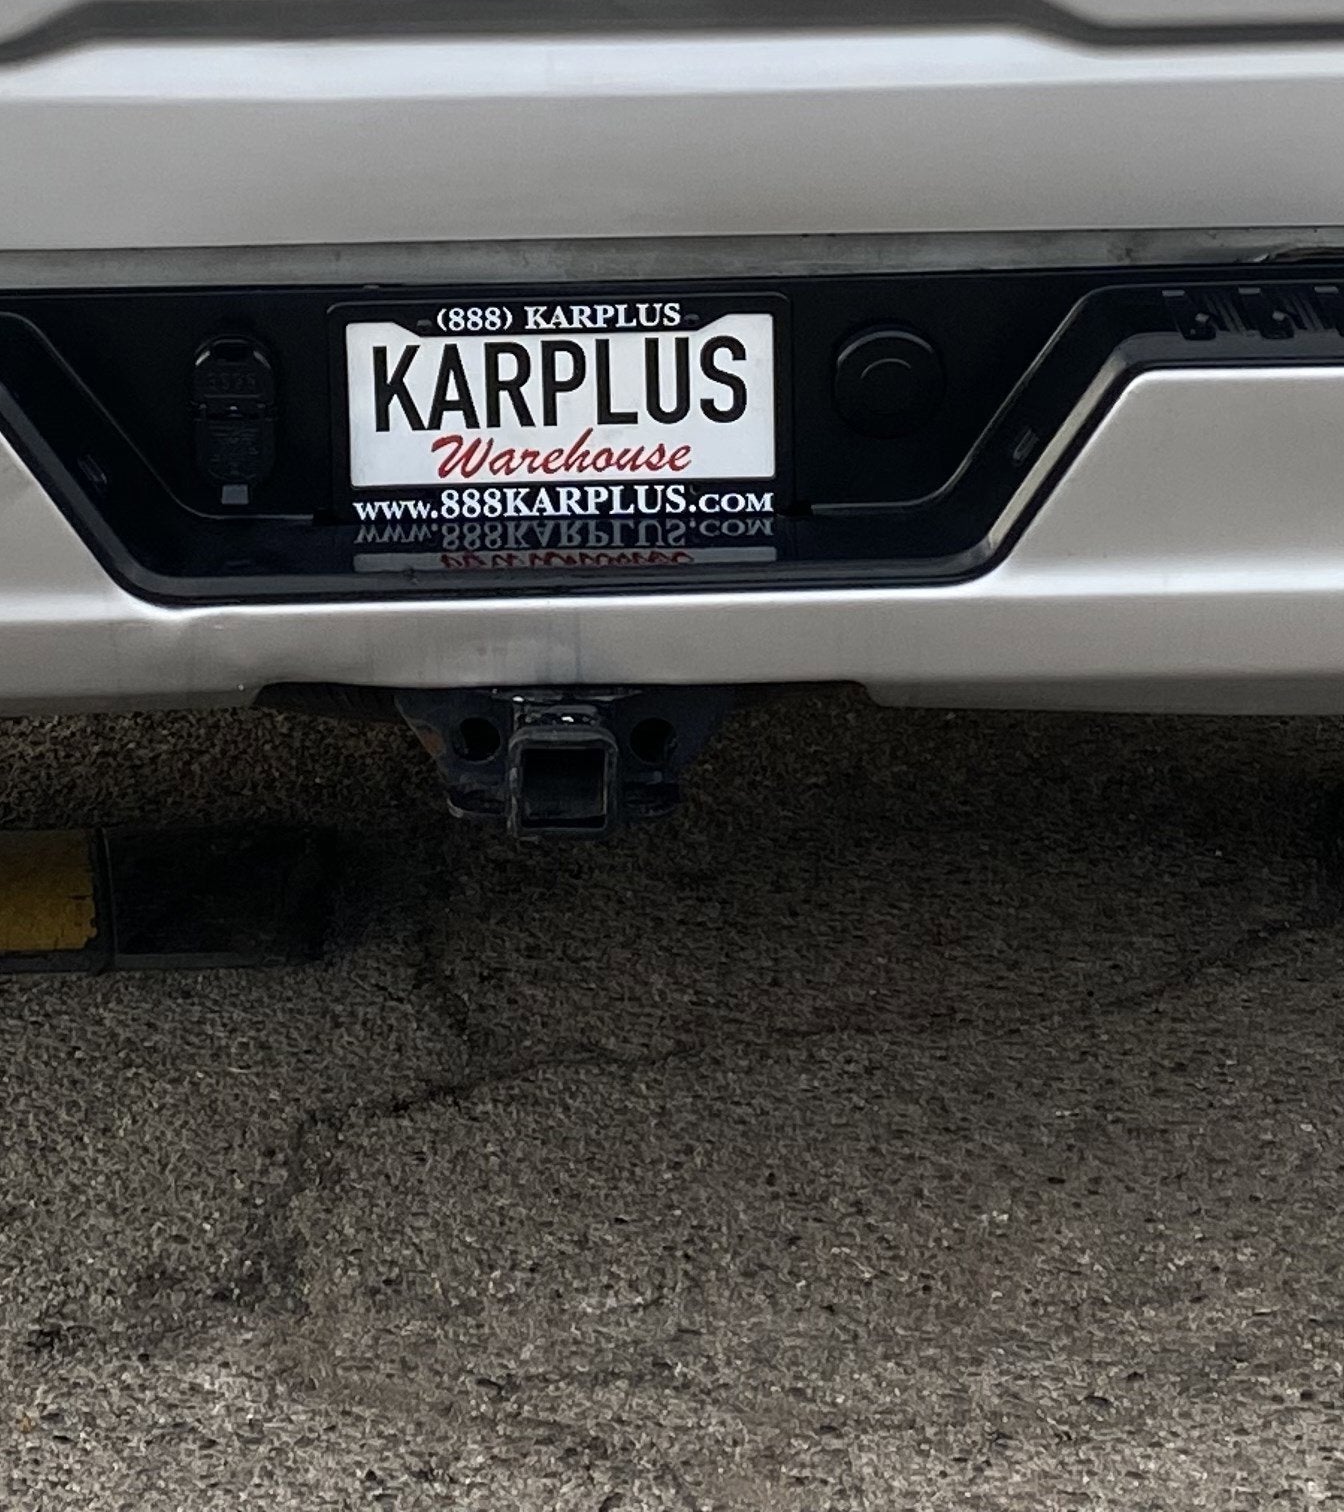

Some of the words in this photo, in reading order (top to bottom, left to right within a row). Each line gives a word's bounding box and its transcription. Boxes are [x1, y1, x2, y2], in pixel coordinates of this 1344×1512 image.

[437, 305, 513, 332] (888)
[525, 303, 681, 329] KARPLUS
[372, 335, 748, 432] KARPLUS
[430, 428, 692, 479] Warehouse
